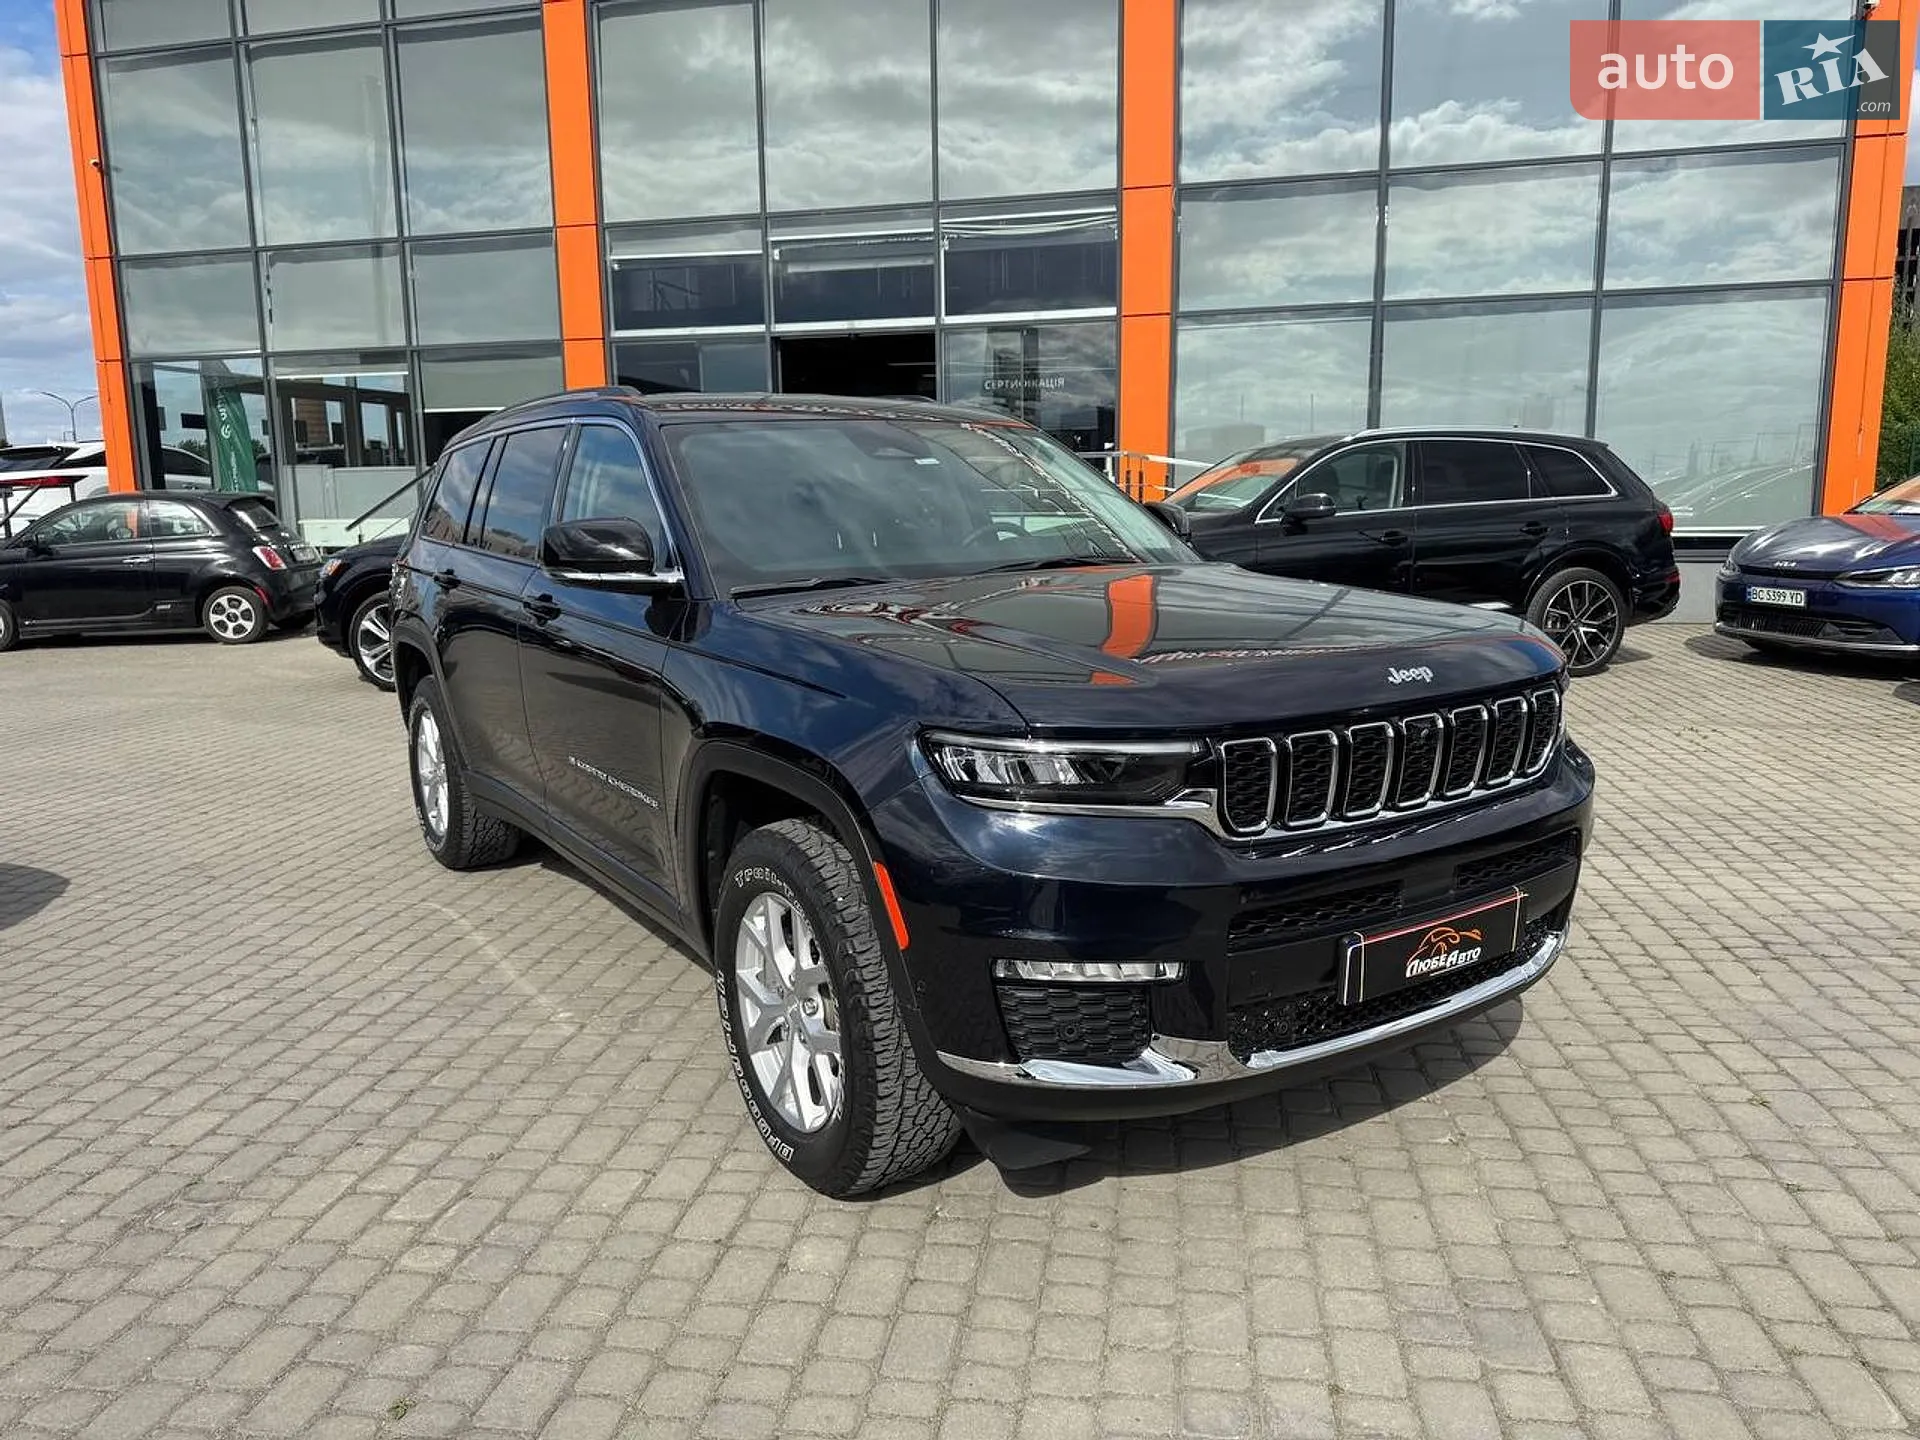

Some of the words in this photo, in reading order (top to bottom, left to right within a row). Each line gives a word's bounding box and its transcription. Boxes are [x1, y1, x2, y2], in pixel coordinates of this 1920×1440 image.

[984, 377, 1065, 390] СЕРТИФІКАЦІЯ
[1752, 588, 1765, 601] BC
[1766, 589, 1787, 602] 5399
[1388, 666, 1433, 685] Jeep
